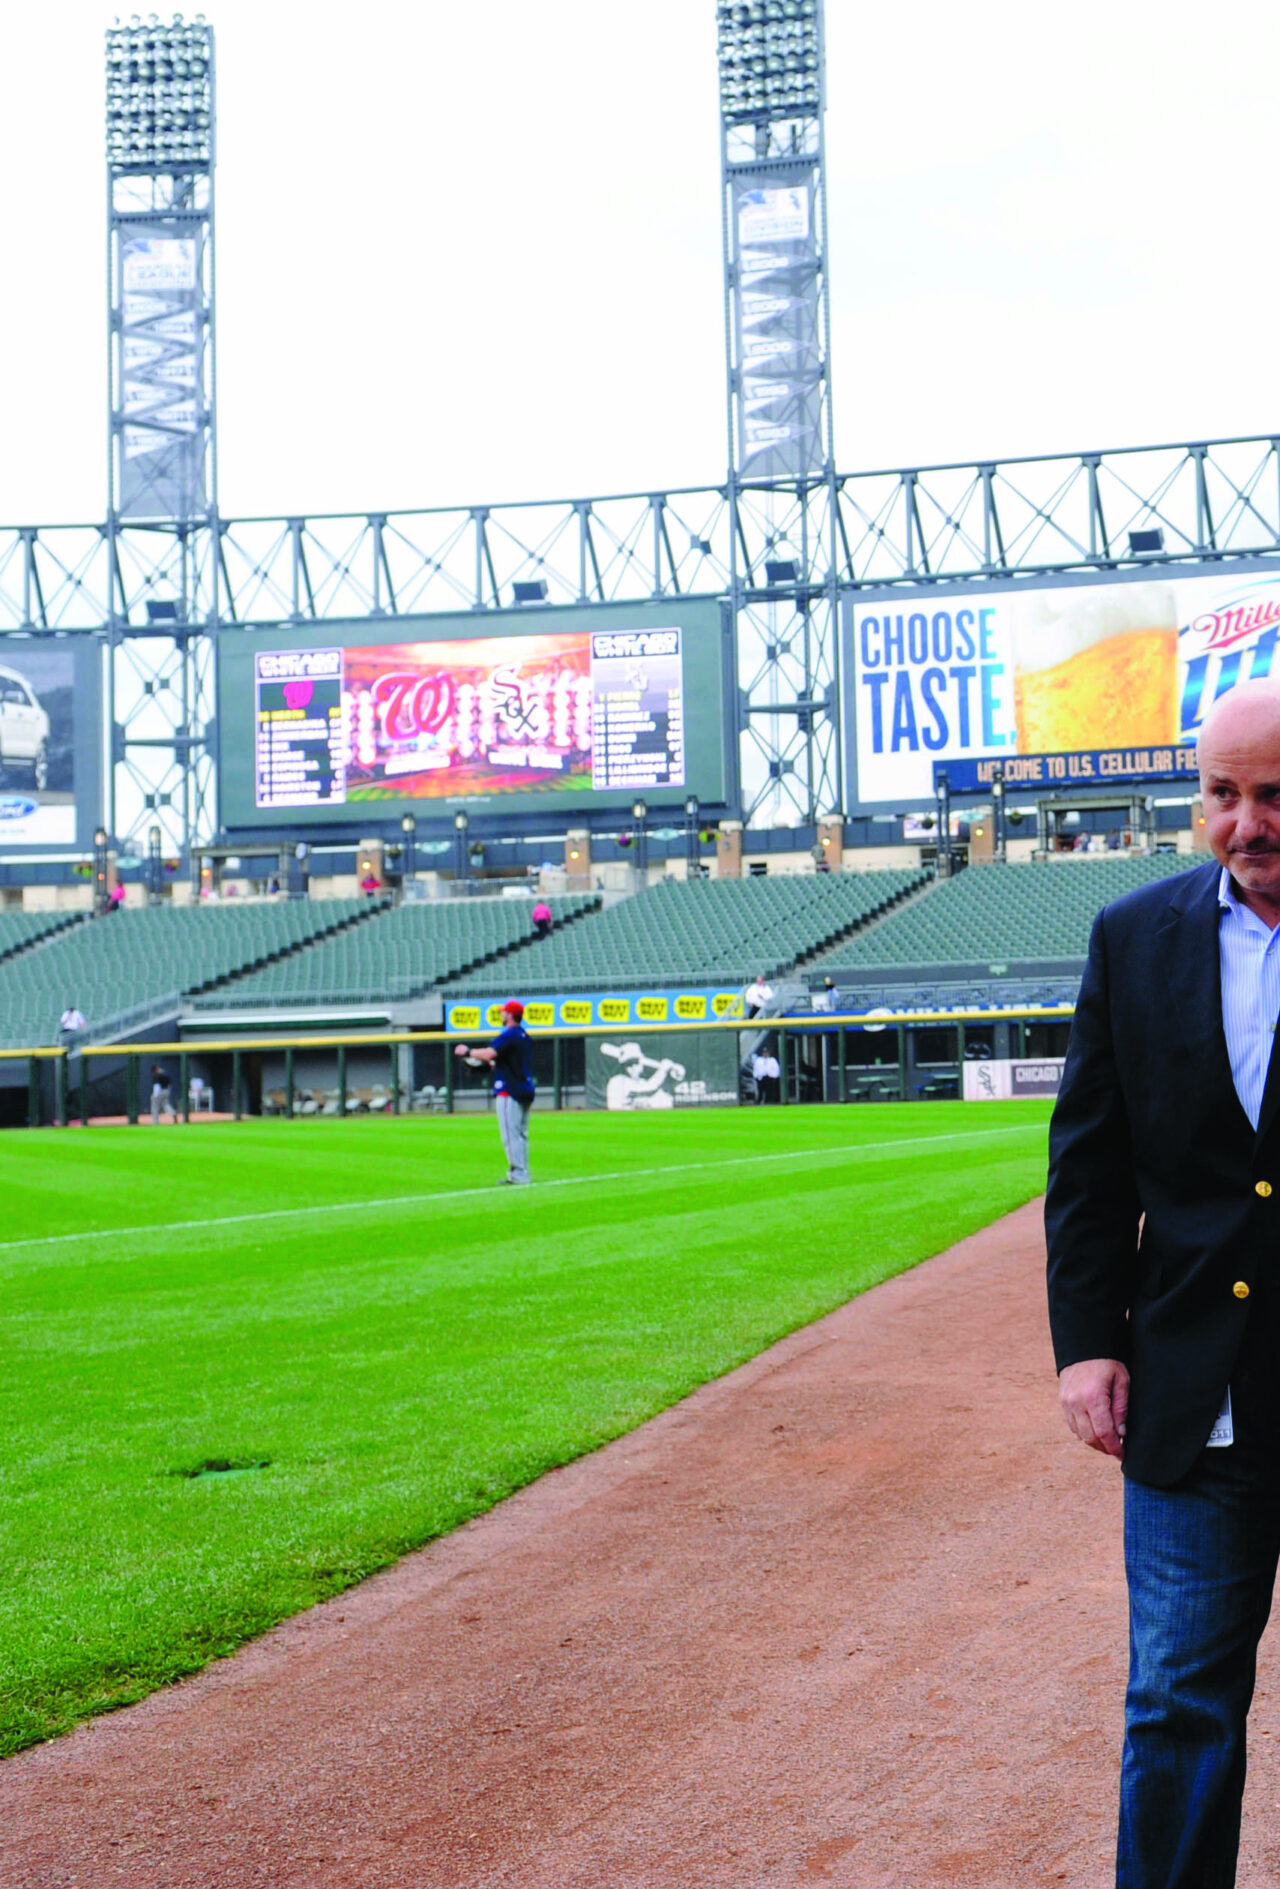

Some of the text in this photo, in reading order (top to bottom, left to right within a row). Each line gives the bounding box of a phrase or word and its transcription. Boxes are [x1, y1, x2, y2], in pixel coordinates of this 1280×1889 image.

[860, 608, 997, 668] CHOOSE
[1046, 757, 1066, 778] TO
[1068, 754, 1095, 778] U.S.
[1099, 750, 1173, 775] CELLULAR
[1175, 749, 1199, 770] FIE
[1015, 1065, 1059, 1083] CHICAGO
